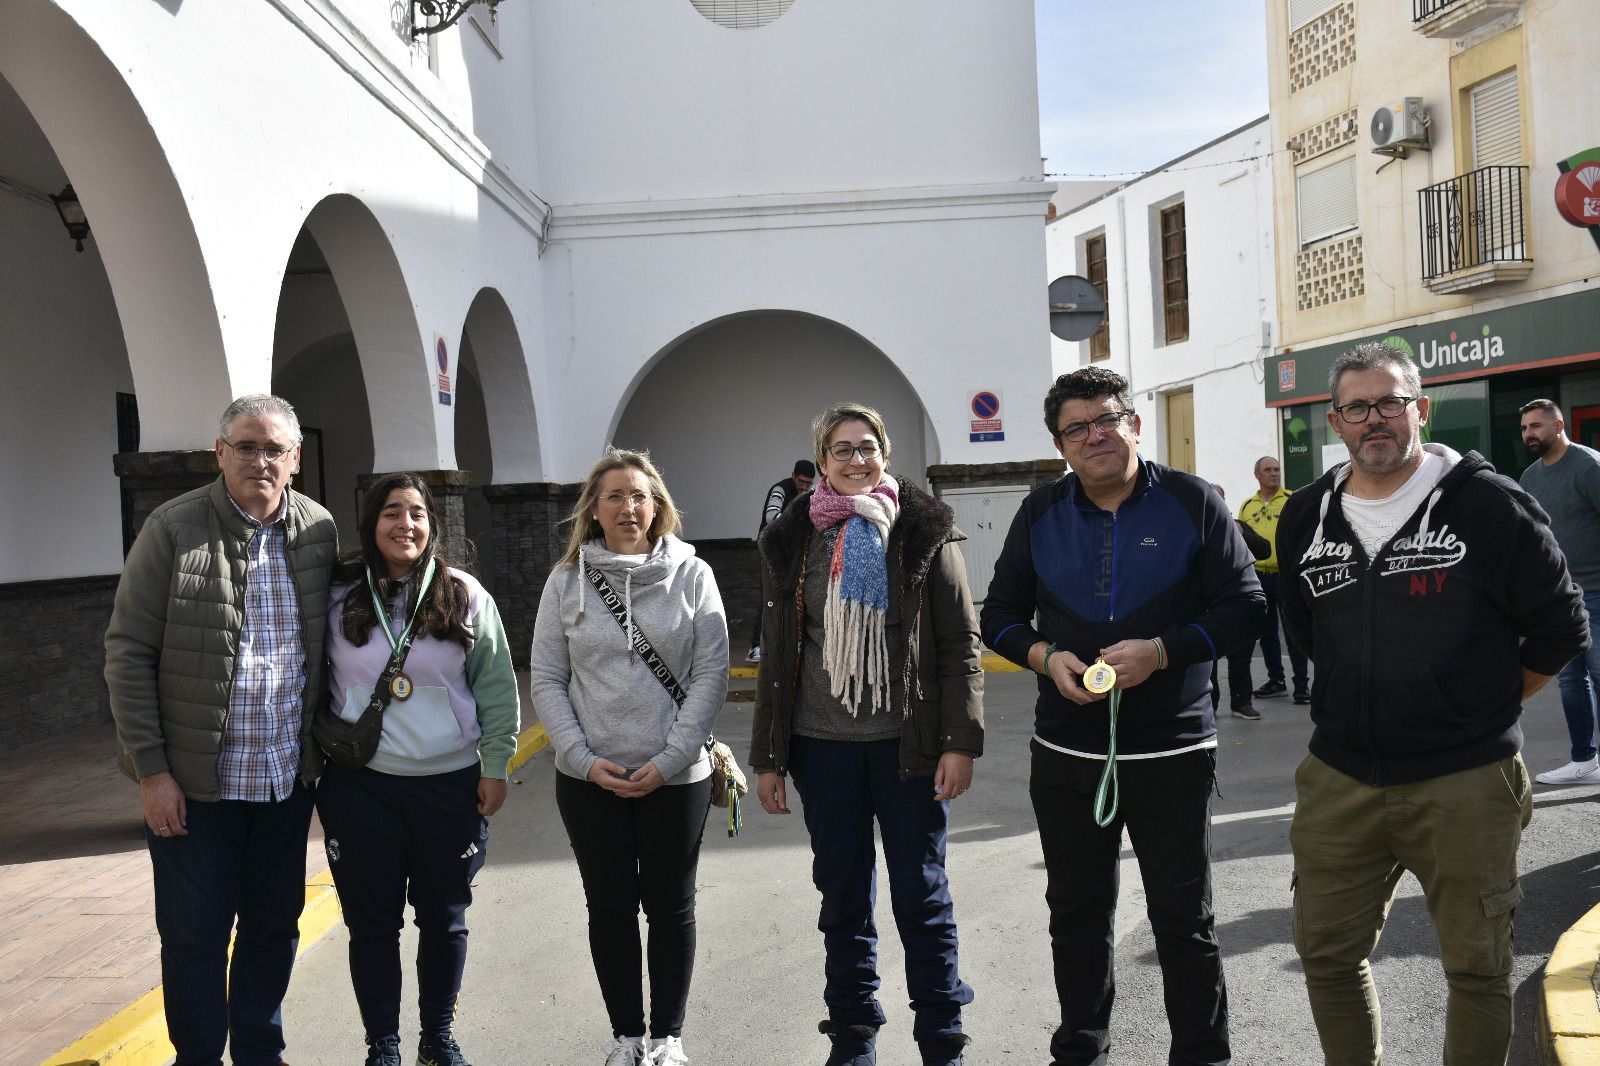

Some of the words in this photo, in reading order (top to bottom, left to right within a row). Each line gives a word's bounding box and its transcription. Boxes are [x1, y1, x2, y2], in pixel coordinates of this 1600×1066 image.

[1420, 325, 1504, 369] Unicaja
[1317, 568, 1351, 587] ATHL
[1409, 570, 1448, 597] NY
[598, 582, 622, 611] LOLA
[647, 653, 673, 684] LOLA
